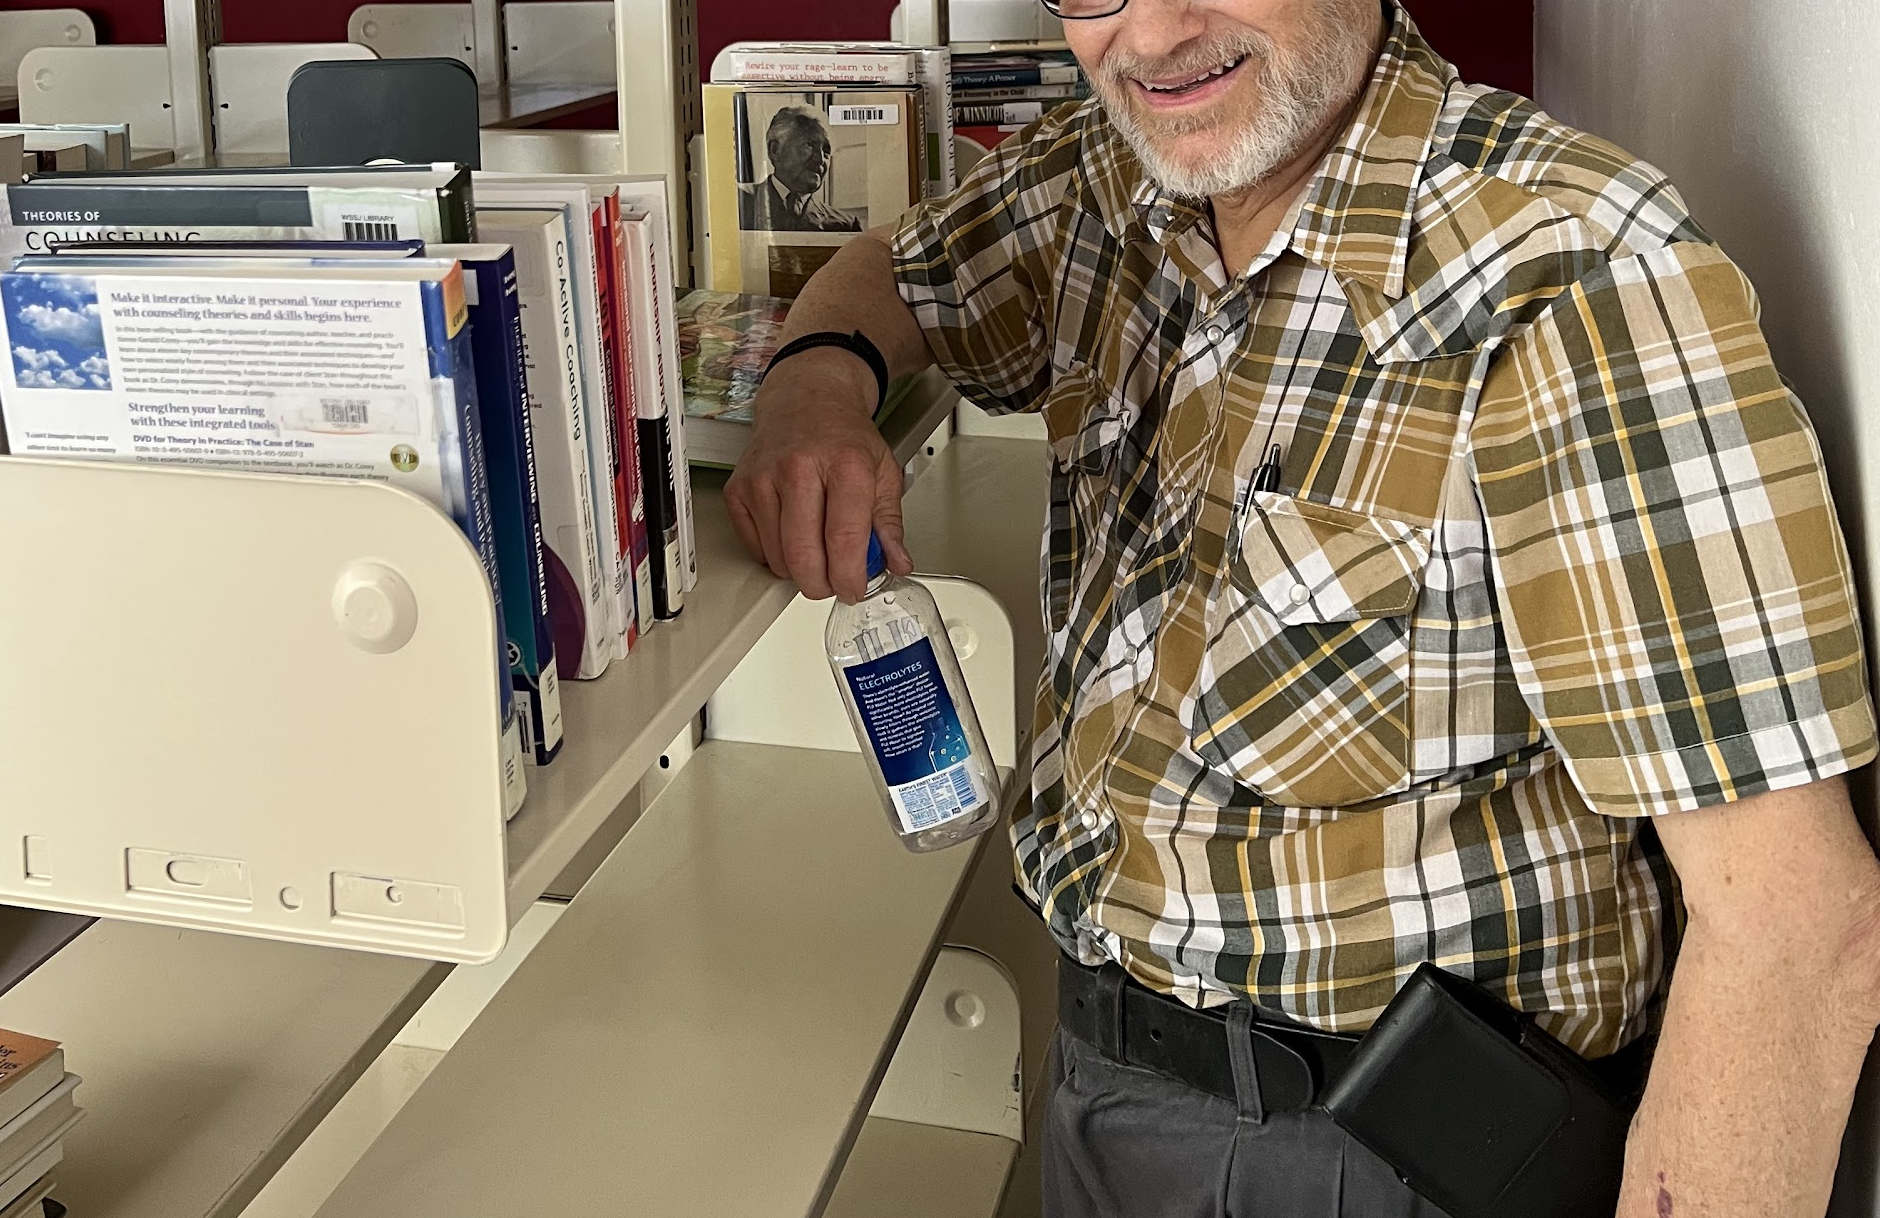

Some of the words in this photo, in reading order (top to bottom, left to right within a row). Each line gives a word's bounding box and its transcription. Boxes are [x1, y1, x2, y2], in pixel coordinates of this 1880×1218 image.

[745, 61, 775, 70] Rewire
[780, 63, 801, 72] your
[878, 64, 888, 72] be
[22, 211, 81, 222] THEORIES
[84, 212, 100, 222] OF
[111, 292, 140, 303] Make
[142, 293, 150, 303] it
[216, 295, 245, 304] Make
[248, 296, 256, 305] it
[312, 297, 337, 306] Your
[340, 298, 401, 309] experience
[114, 307, 139, 317] with
[142, 308, 200, 320] counseling
[203, 309, 248, 319] theories
[250, 310, 271, 320] and
[274, 311, 302, 320] skills
[305, 312, 342, 323] begins
[556, 241, 571, 337] Co-Active
[566, 344, 582, 441] Coaching
[622, 261, 631, 332] Intentional
[628, 334, 637, 417] Interviewing
[649, 242, 661, 345] LEADERSHIP
[657, 353, 667, 409] ABOVE
[596, 325, 604, 374] DIVERSITY
[128, 402, 190, 414] Strengthen
[192, 406, 216, 415] your
[219, 405, 265, 417] learning
[131, 417, 156, 426] with
[159, 417, 187, 427] these
[190, 418, 246, 430] integrated
[153, 435, 165, 443] for
[167, 436, 196, 445] Theory
[208, 437, 244, 445] Practice:
[246, 438, 261, 446] The
[611, 405, 619, 465] Counseling
[466, 404, 479, 500] Counseling
[475, 501, 485, 542] and
[520, 392, 537, 503] INTERVIEWING
[532, 522, 548, 616] COUNSELING
[482, 492, 491, 524] and
[487, 524, 498, 590] Practice
[858, 661, 922, 690] ELECTROLYTES
